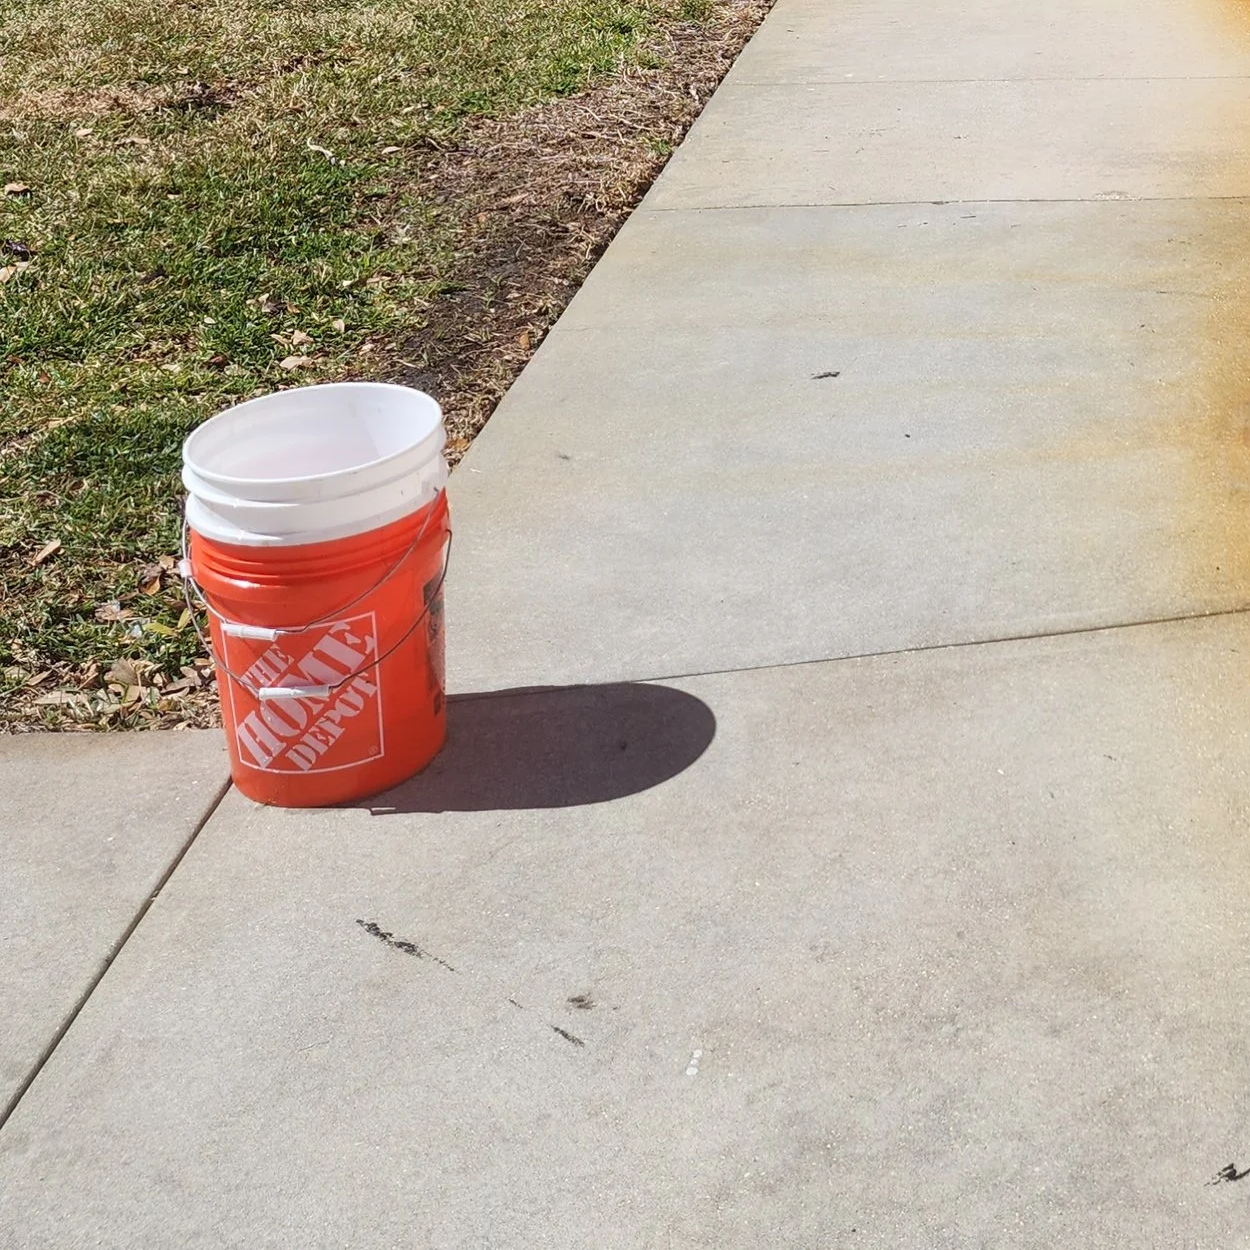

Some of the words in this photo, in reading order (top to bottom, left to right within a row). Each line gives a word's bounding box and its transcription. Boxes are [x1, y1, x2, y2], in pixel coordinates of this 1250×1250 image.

[237, 621, 376, 768] HOME
[239, 643, 294, 697] THE
[286, 672, 377, 771] DEPOT
